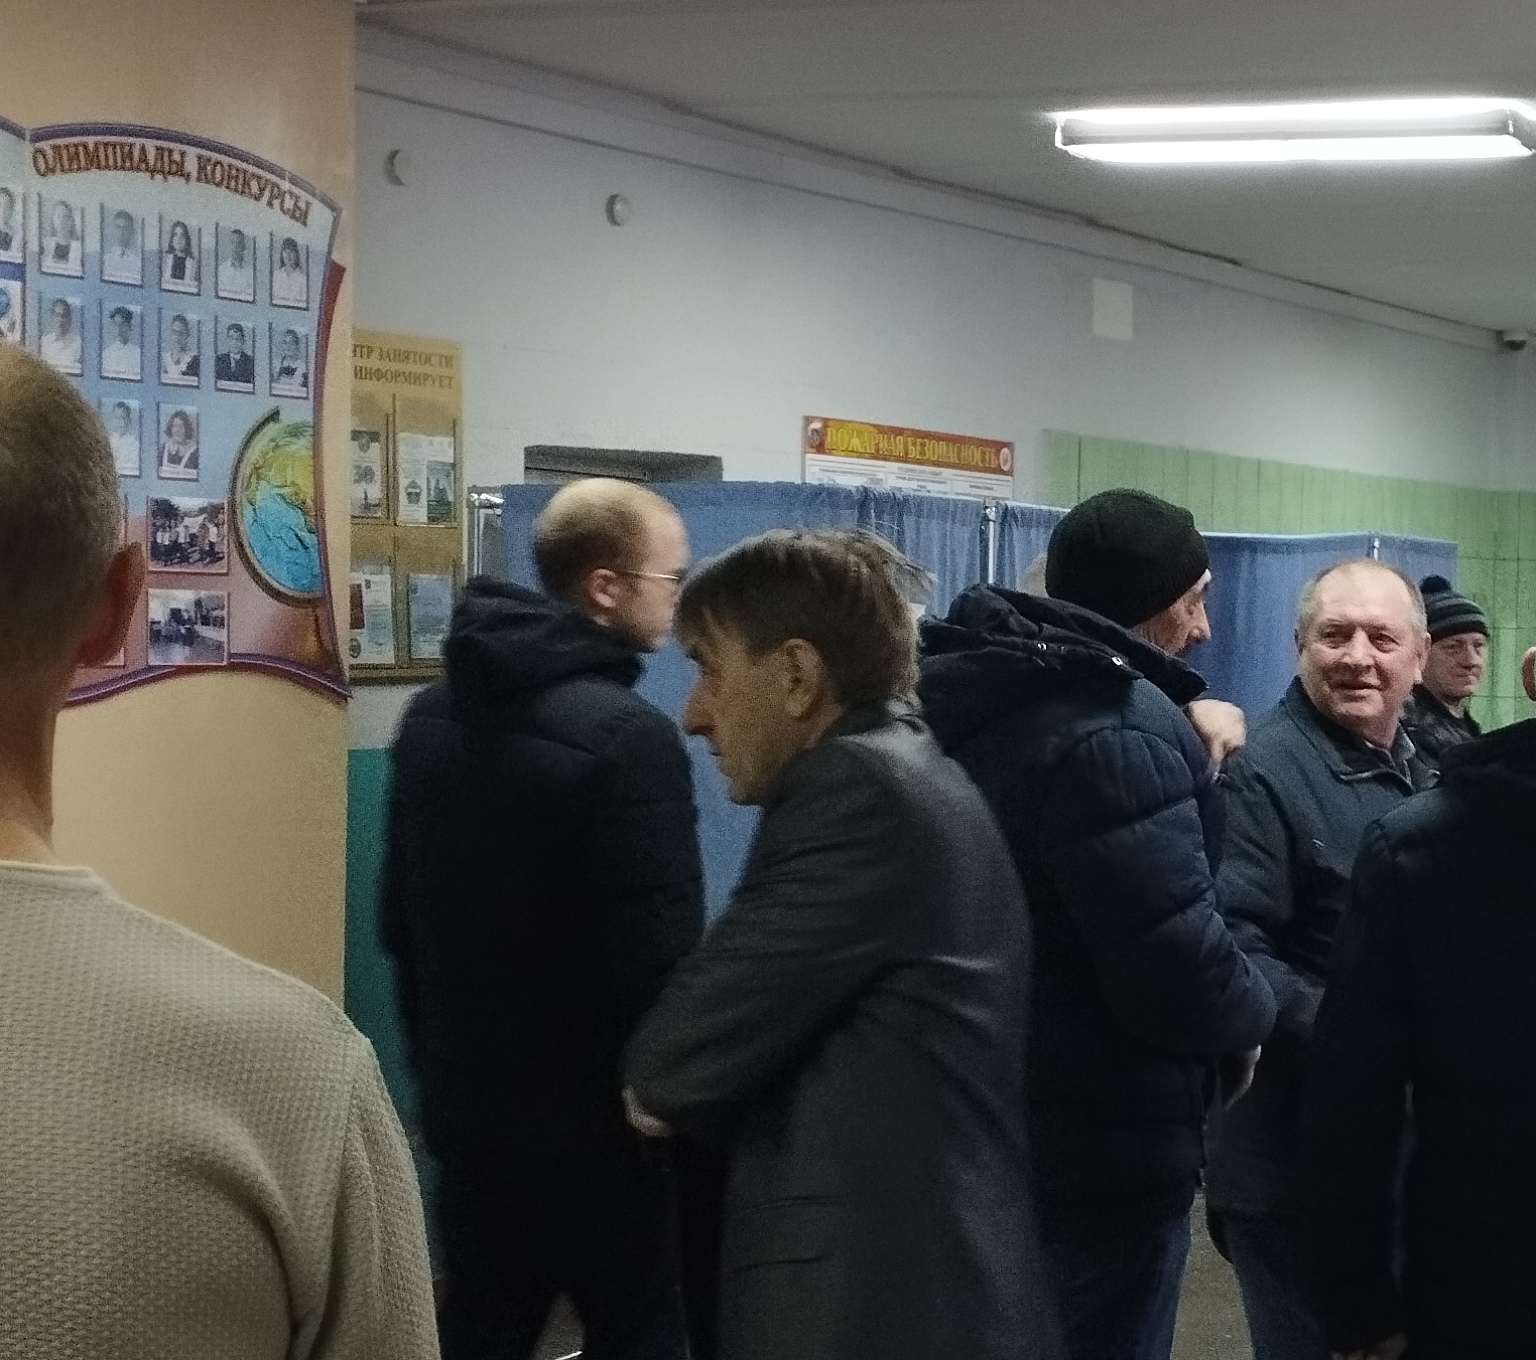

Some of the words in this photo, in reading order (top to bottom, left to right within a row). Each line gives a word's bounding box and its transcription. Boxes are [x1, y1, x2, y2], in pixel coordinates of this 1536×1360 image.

[32, 140, 191, 183] ОЛИМПИАДЫ,
[196, 153, 312, 227] КОНКУРСЫ
[378, 346, 454, 369] ЗАНЯТОСТИ
[353, 364, 453, 389] ИНФОРМИРУЕТ
[826, 427, 904, 457] ПОЖАРНАЯ
[907, 437, 999, 468] БЕЗОПАСНОСТЬ
